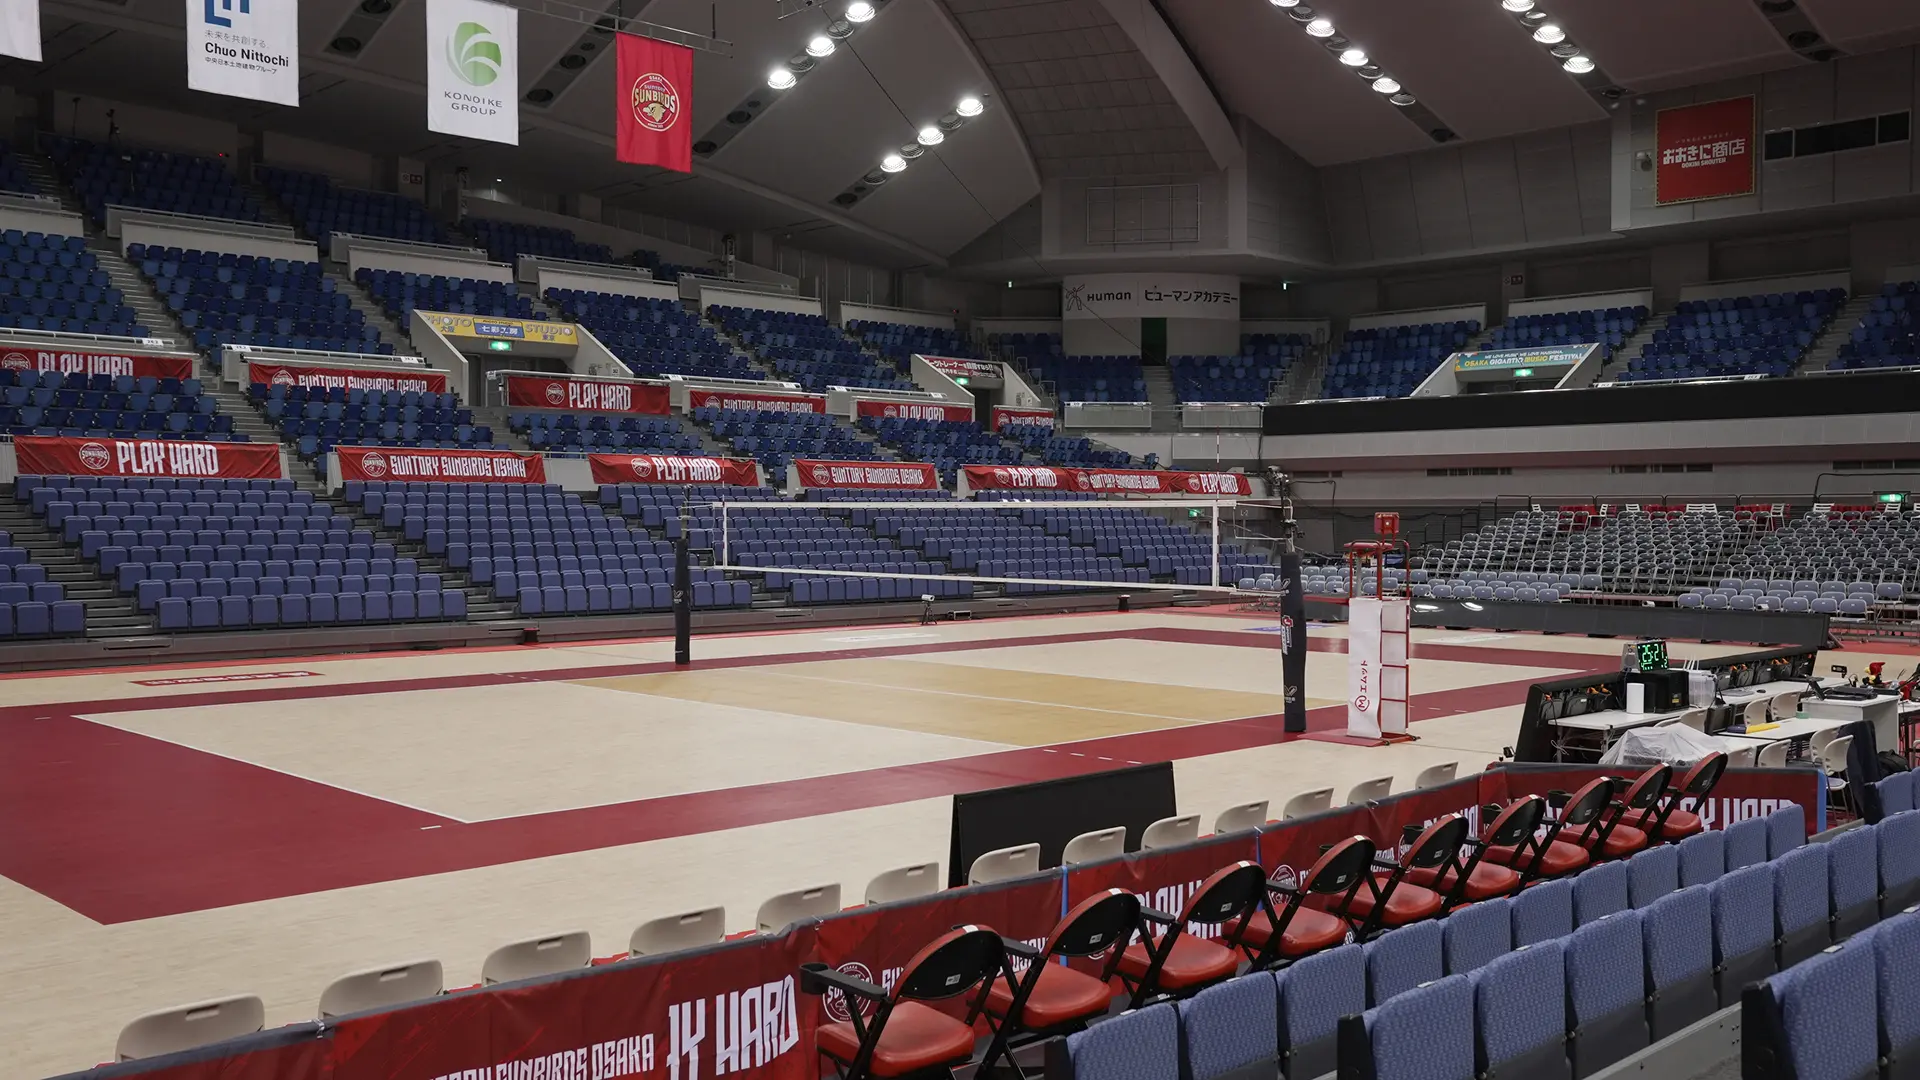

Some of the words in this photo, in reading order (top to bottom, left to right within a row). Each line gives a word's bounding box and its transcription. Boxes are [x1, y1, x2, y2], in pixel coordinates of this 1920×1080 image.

[205, 41, 237, 58] Chuo
[241, 48, 289, 67] Nittochi
[444, 91, 503, 108] KONOIKE
[451, 102, 497, 116] GROUP
[634, 88, 676, 114] SUNBIRDS
[1663, 139, 1746, 165] おおきに商店
[1144, 290, 1238, 303] ヒューマンアカデミー
[482, 325, 519, 335] 七彩工房
[525, 323, 574, 336] STUDIO
[1464, 359, 1488, 367] OSAKA
[1524, 355, 1548, 363] MUSIC
[1549, 352, 1584, 361] FESTIVAL
[568, 382, 598, 408] PLAY
[601, 384, 632, 411] HARD
[115, 441, 165, 473] PLAY
[168, 443, 219, 475] HARD
[389, 455, 439, 475] SUNTORY
[442, 456, 492, 477] SUNBIRDS
[493, 457, 527, 478] OSAKA
[651, 457, 685, 481] PLAY
[685, 458, 721, 481] HARD
[830, 466, 864, 483] SUNTORY
[865, 467, 900, 484] SUNBIRDS
[900, 468, 924, 485] OSAKA
[1007, 467, 1034, 486] PLAY
[1360, 660, 1368, 693] エムット
[715, 973, 799, 1076] HARD
[591, 1033, 654, 1080] OSAKA
